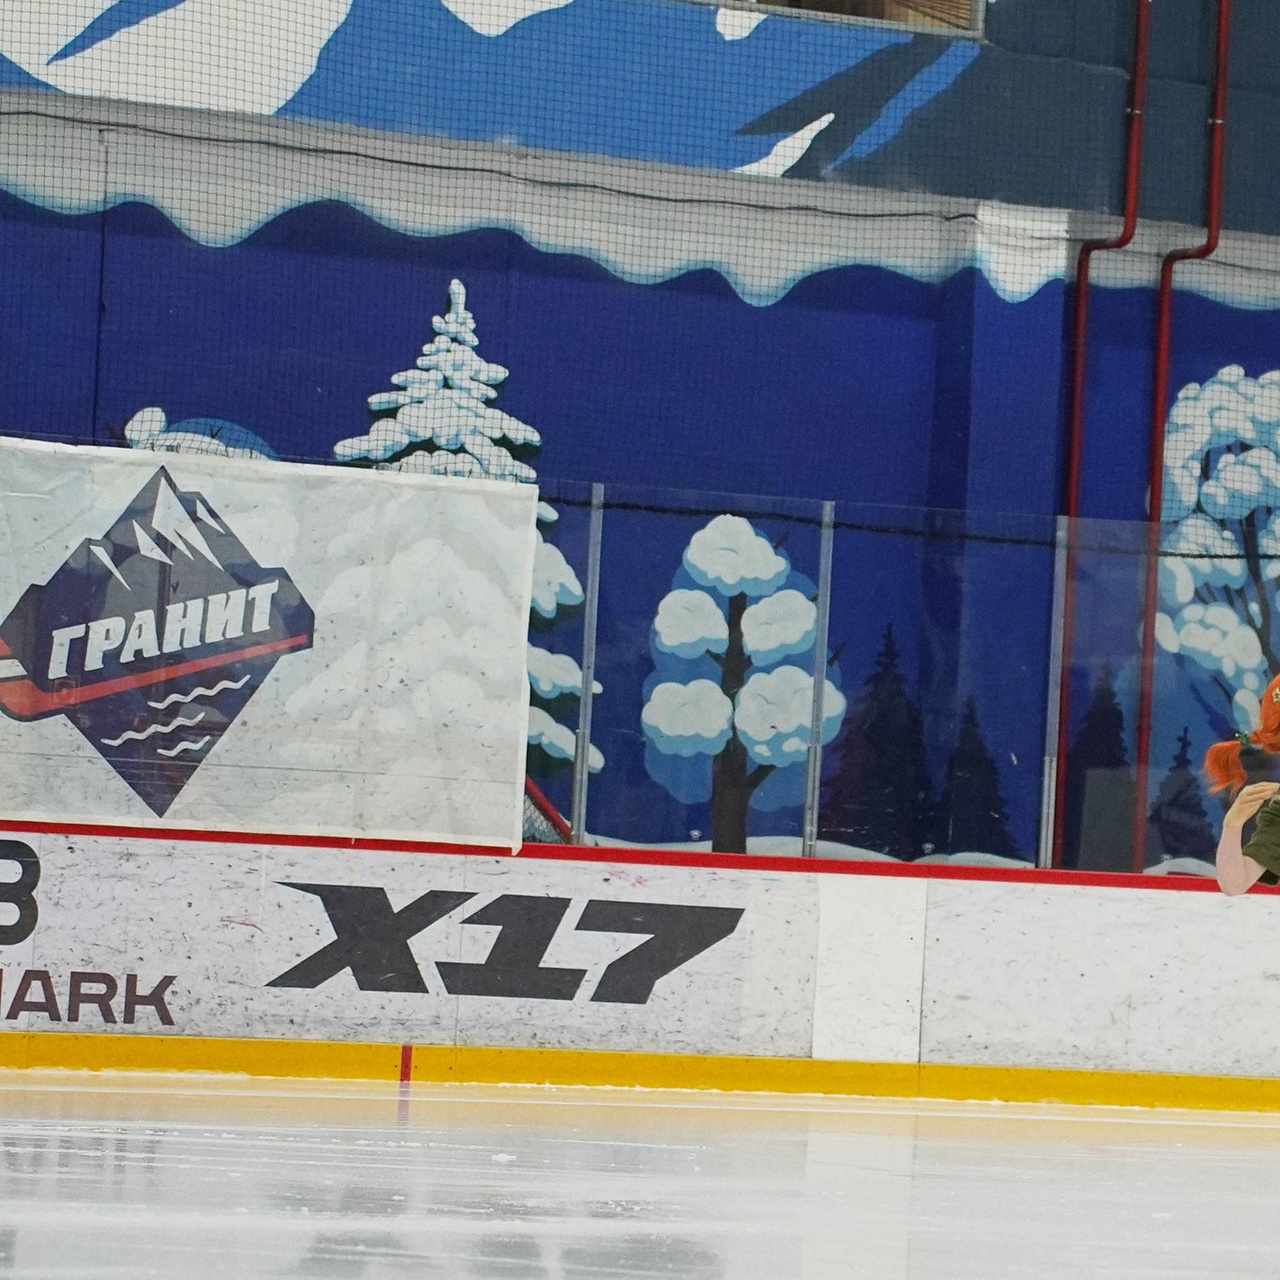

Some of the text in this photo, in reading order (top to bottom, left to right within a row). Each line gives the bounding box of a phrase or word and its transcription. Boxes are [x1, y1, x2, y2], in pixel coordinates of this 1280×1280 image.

[48, 579, 279, 680] ГРАНИТ
[264, 880, 746, 1005] X17
[0, 968, 178, 1026] ARK
